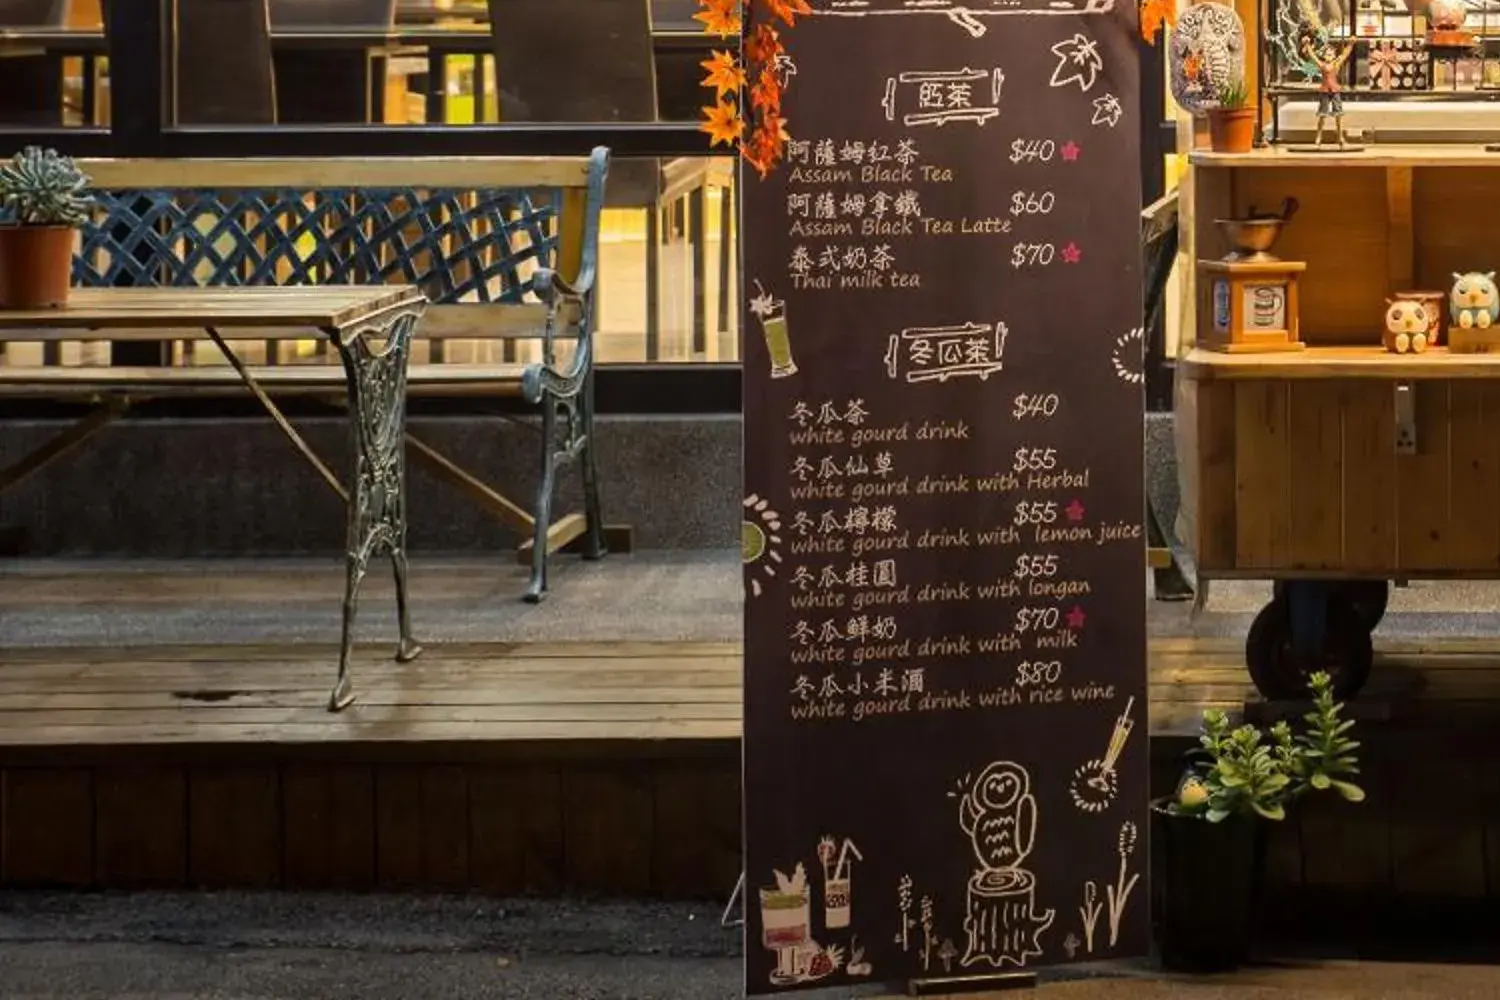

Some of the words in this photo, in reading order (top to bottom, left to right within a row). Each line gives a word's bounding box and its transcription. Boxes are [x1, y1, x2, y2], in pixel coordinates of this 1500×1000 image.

[1008, 140, 1055, 164] $40
[788, 167, 853, 183] Assam
[861, 164, 913, 183] Black
[920, 165, 953, 182] Tea
[1009, 191, 1056, 216] $60
[788, 220, 853, 237] Assam
[861, 217, 913, 236] Black
[920, 218, 953, 234] Tea
[961, 217, 1012, 233] Latte
[1010, 242, 1055, 267] $70
[790, 272, 834, 289] Thai
[840, 271, 883, 288] milk
[890, 271, 921, 288] tea
[789, 398, 870, 426] 冬瓜茶
[1012, 393, 1060, 420] $40
[789, 425, 845, 444] white
[851, 422, 908, 447] gourd
[916, 421, 969, 440] drink
[790, 452, 894, 480] 冬瓜仙草
[1012, 447, 1057, 472] $55
[790, 480, 844, 499] white
[852, 476, 909, 502] gourd
[917, 474, 969, 494] drink
[976, 472, 1019, 491] with
[1027, 470, 1089, 489] Herbal
[789, 505, 897, 536] 冬瓜檸檬
[1014, 501, 1058, 526] $55
[791, 534, 844, 554] white
[852, 531, 909, 557] gourd
[917, 529, 970, 548] drink
[977, 526, 1020, 545] with
[1035, 524, 1093, 542] lemon
[1096, 521, 1141, 545] juice
[1014, 554, 1060, 578] $55
[791, 591, 845, 608] white
[852, 586, 910, 611] gourd
[917, 583, 970, 602] drink
[977, 581, 1020, 599] with
[1028, 579, 1091, 600] longan
[1014, 607, 1060, 632] $70
[791, 644, 845, 663] white
[852, 641, 910, 666] gourd
[917, 638, 971, 656] drink
[978, 636, 1021, 653] with
[1036, 633, 1078, 649] milk
[1015, 661, 1062, 687] $80
[791, 700, 845, 720] white
[853, 698, 911, 722] gourd
[918, 690, 971, 709] drink
[978, 689, 1021, 706] with
[1029, 688, 1063, 703] rice
[1071, 683, 1115, 701] wine
